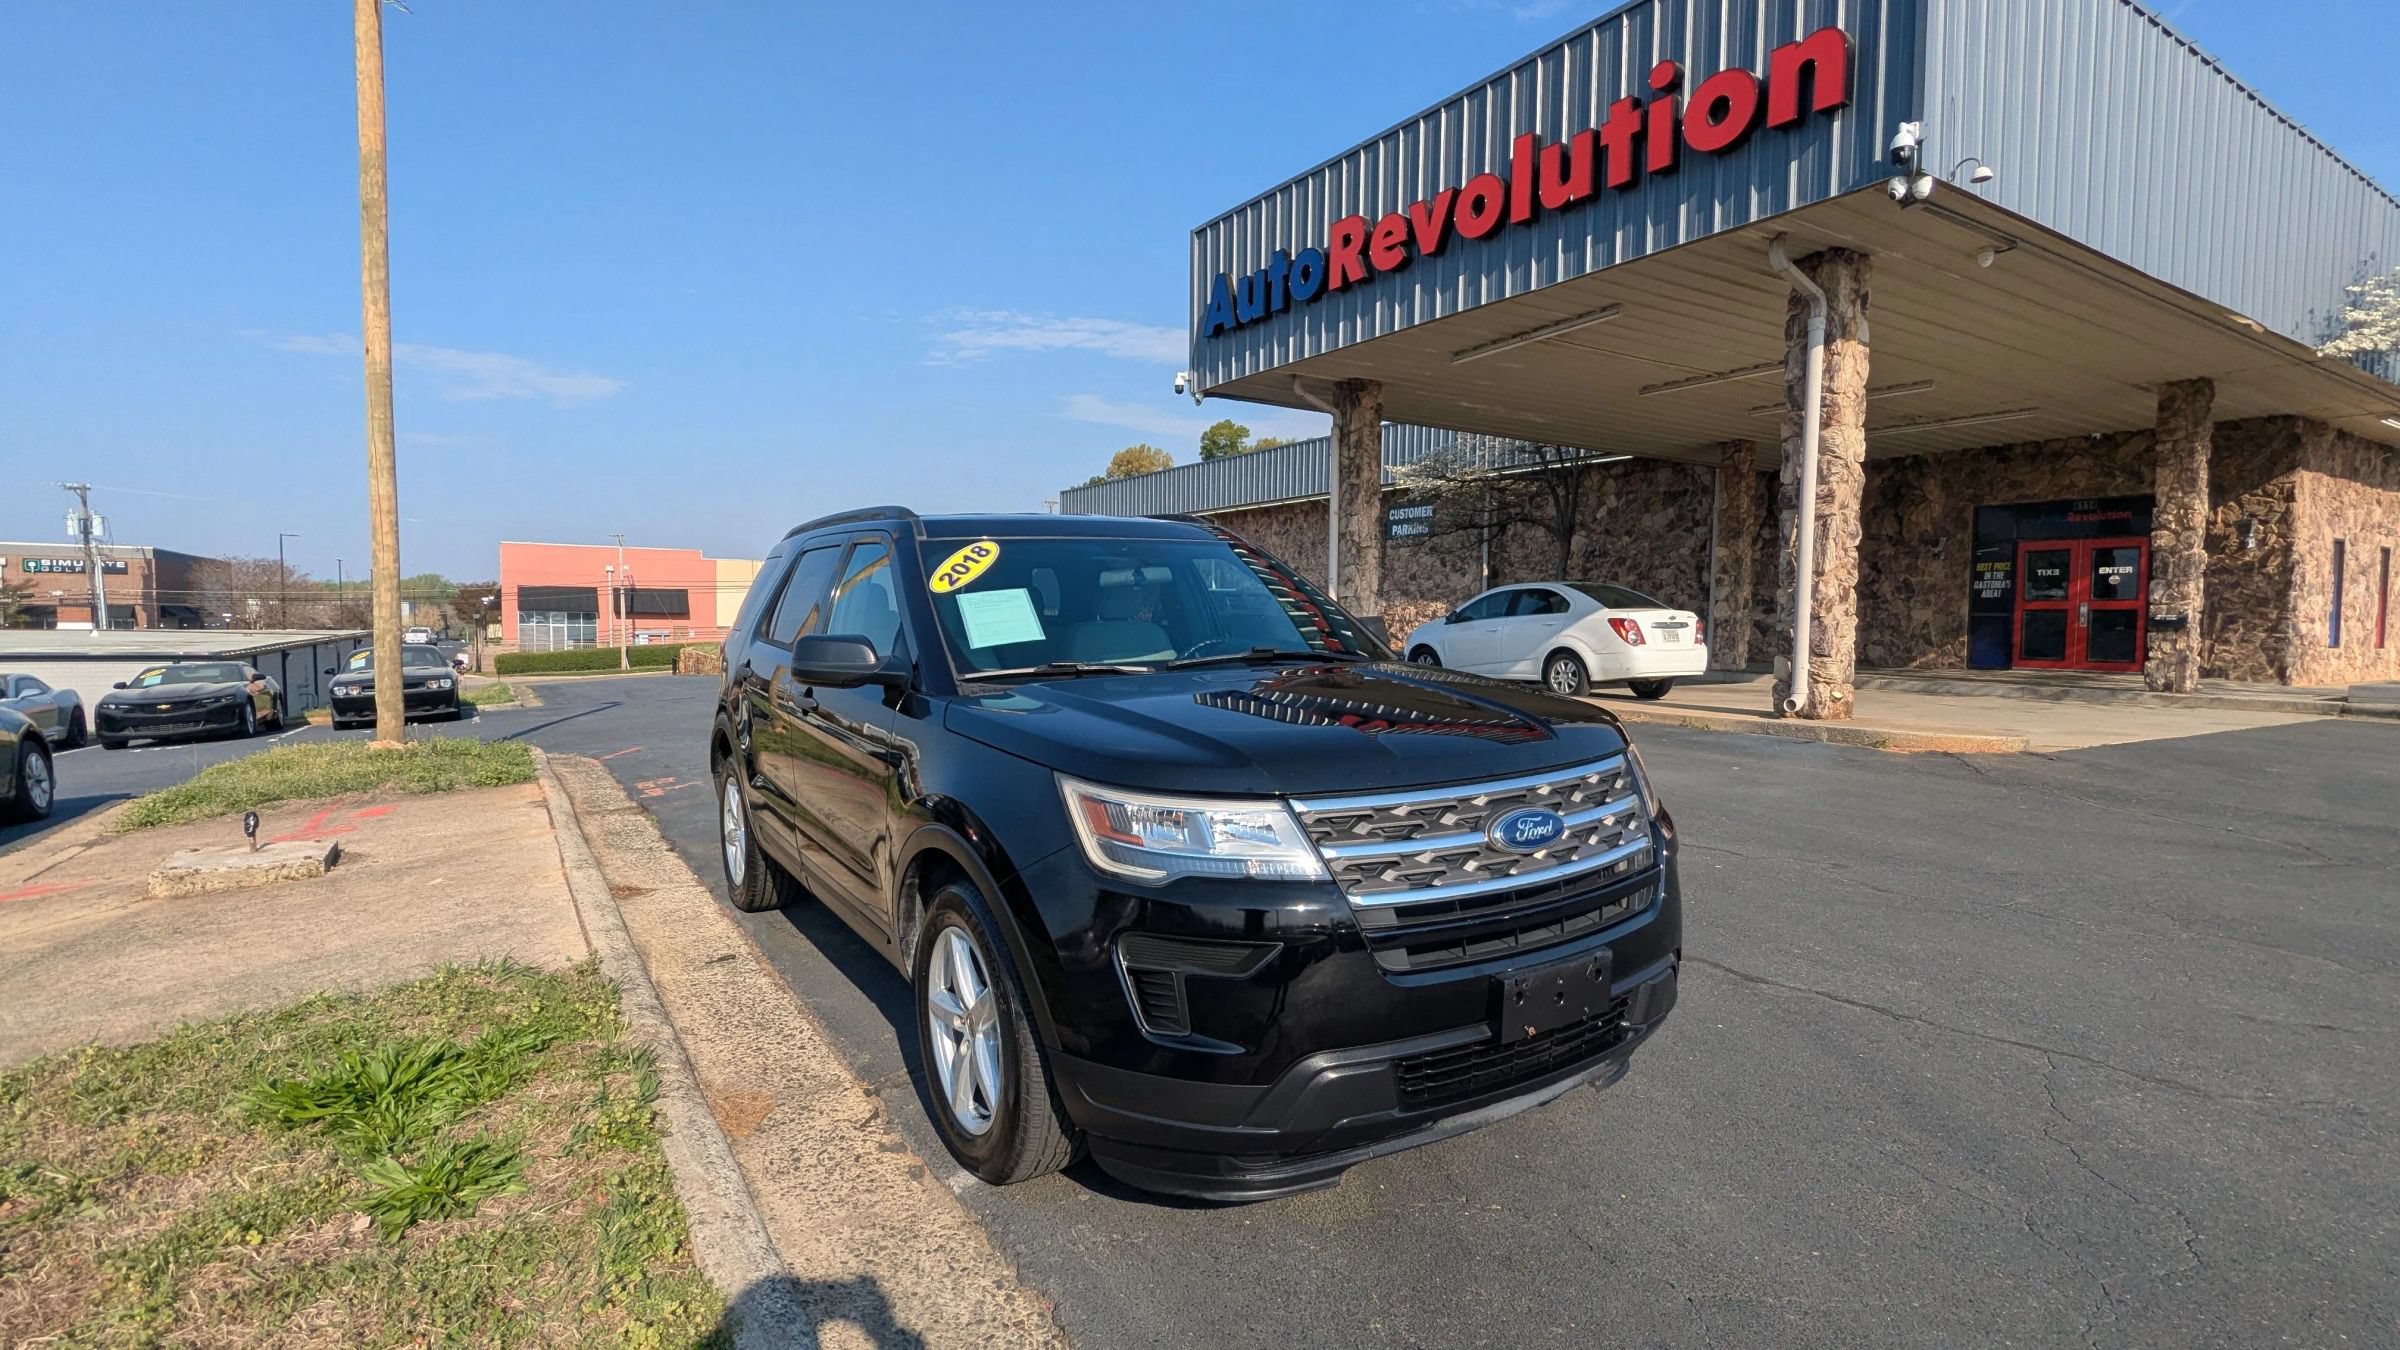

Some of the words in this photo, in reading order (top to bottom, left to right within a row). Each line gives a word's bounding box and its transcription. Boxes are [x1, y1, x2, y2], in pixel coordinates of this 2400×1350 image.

[1389, 506, 1433, 520] CUSTOMER
[1391, 523, 1429, 536] PARKING
[938, 545, 992, 587] 2018
[2098, 566, 2133, 575] ENTER
[1992, 571, 2005, 580] THE
[1981, 589, 2002, 598] AREA!
[1516, 816, 1554, 842] Ford
